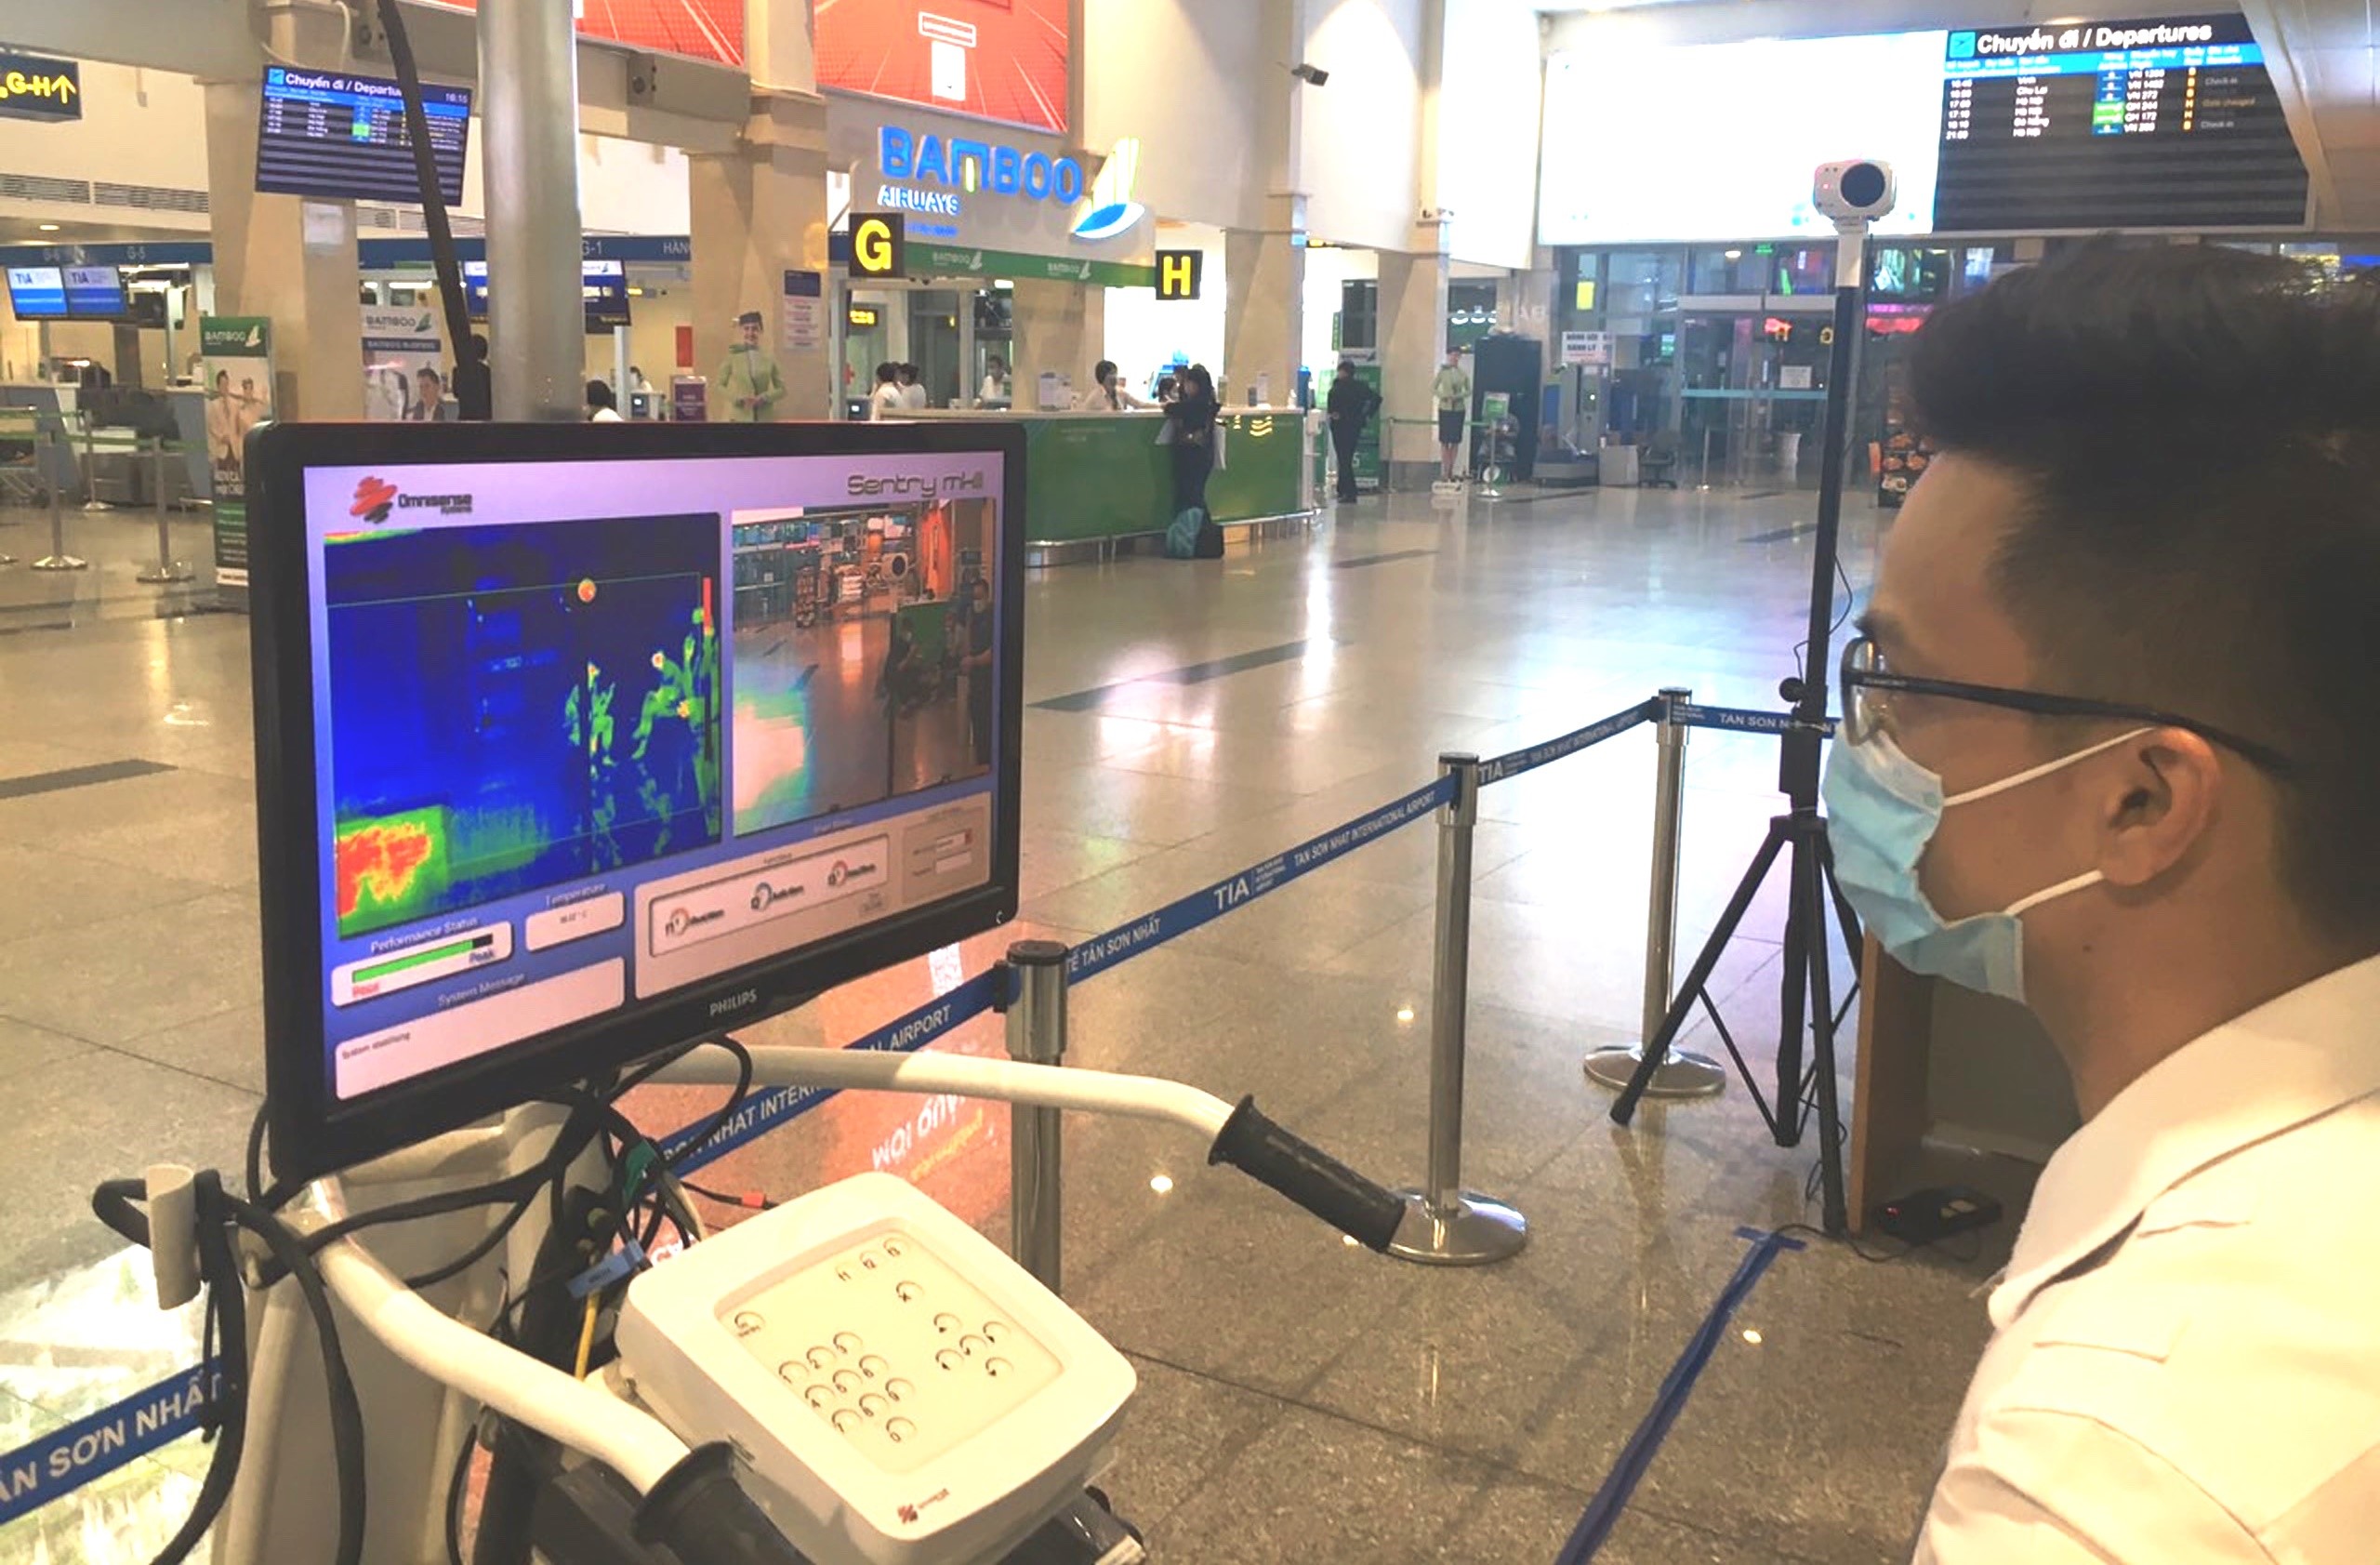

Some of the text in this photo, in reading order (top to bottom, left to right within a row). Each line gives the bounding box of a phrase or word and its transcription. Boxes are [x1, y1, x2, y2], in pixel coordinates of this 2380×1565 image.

[2096, 25, 2213, 48] Departures
[285, 73, 330, 91] Chuyến
[354, 82, 403, 97] Departu
[879, 126, 1084, 205] BAMBOO
[878, 184, 960, 216] AIRWAYS
[855, 219, 892, 272] G
[1163, 256, 1192, 296] H
[366, 316, 416, 327] BAMBOO
[848, 473, 937, 497] Sentry
[1480, 761, 1504, 783] TIA
[1214, 878, 1250, 910] TIA
[371, 917, 478, 953] Performance Status
[437, 974, 525, 1007] System Message
[709, 988, 758, 1016] PHILIPS
[891, 1004, 951, 1051] AIRPORT
[48, 1420, 126, 1478] SƠN
